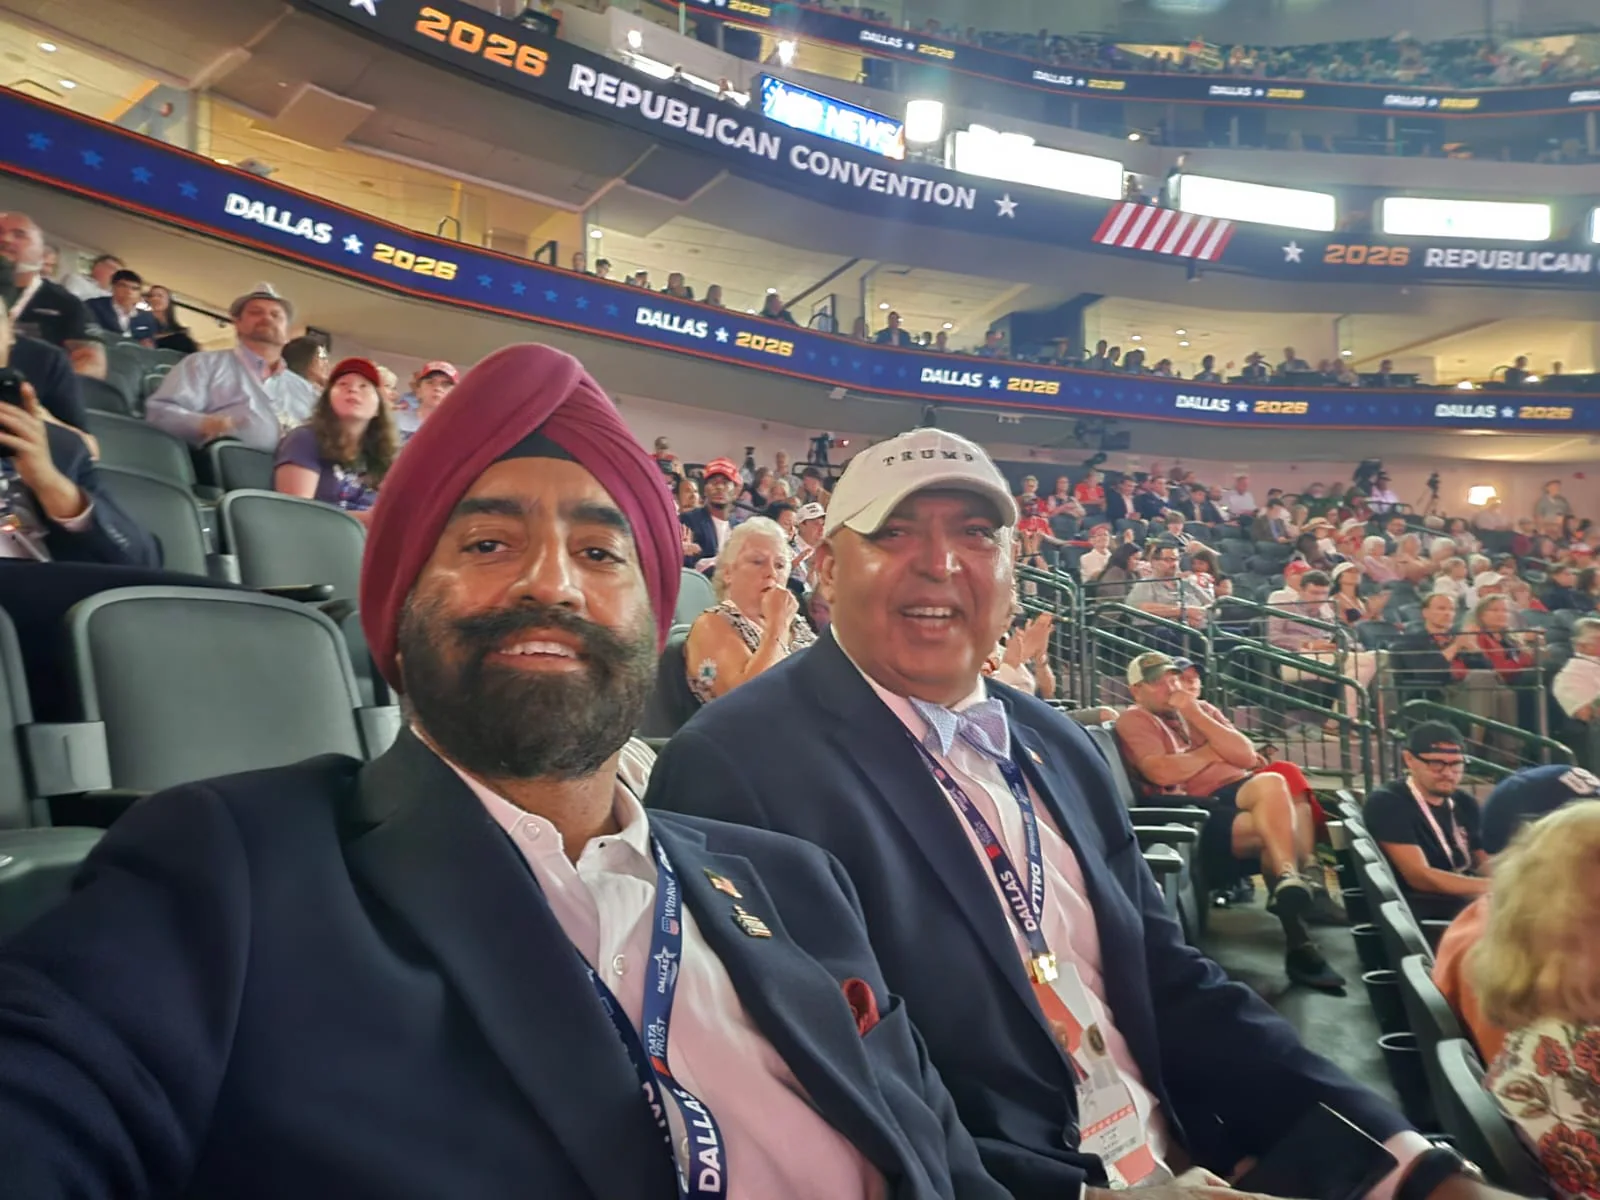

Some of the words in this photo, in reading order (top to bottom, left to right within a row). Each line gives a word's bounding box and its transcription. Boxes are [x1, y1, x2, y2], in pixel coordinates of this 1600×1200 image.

[860, 30, 903, 48] DALLAS
[415, 6, 549, 77] 2026
[568, 63, 782, 160] REPUBLICAN
[790, 144, 977, 210] CONVENTION
[224, 193, 333, 244] DALLAS
[372, 243, 458, 280] 2026
[1323, 244, 1410, 266] 2026
[1424, 248, 1591, 273] REPUBLICAN
[635, 307, 708, 338] DALLAS
[735, 331, 794, 357] 2026
[920, 367, 983, 387] DALLAS
[1007, 377, 1060, 394] 2026
[1175, 394, 1231, 412] DALLAS
[1253, 400, 1309, 414] 2026
[1434, 402, 1497, 418] DALLAS
[882, 449, 974, 466] TRUMP
[1000, 870, 1038, 931] DALLAS
[1030, 861, 1044, 922] DALLA
[656, 957, 671, 994] DALLAS
[648, 1023, 658, 1057] DATA
[653, 1016, 667, 1058] TRUST
[673, 1088, 721, 1193] DALLAS
